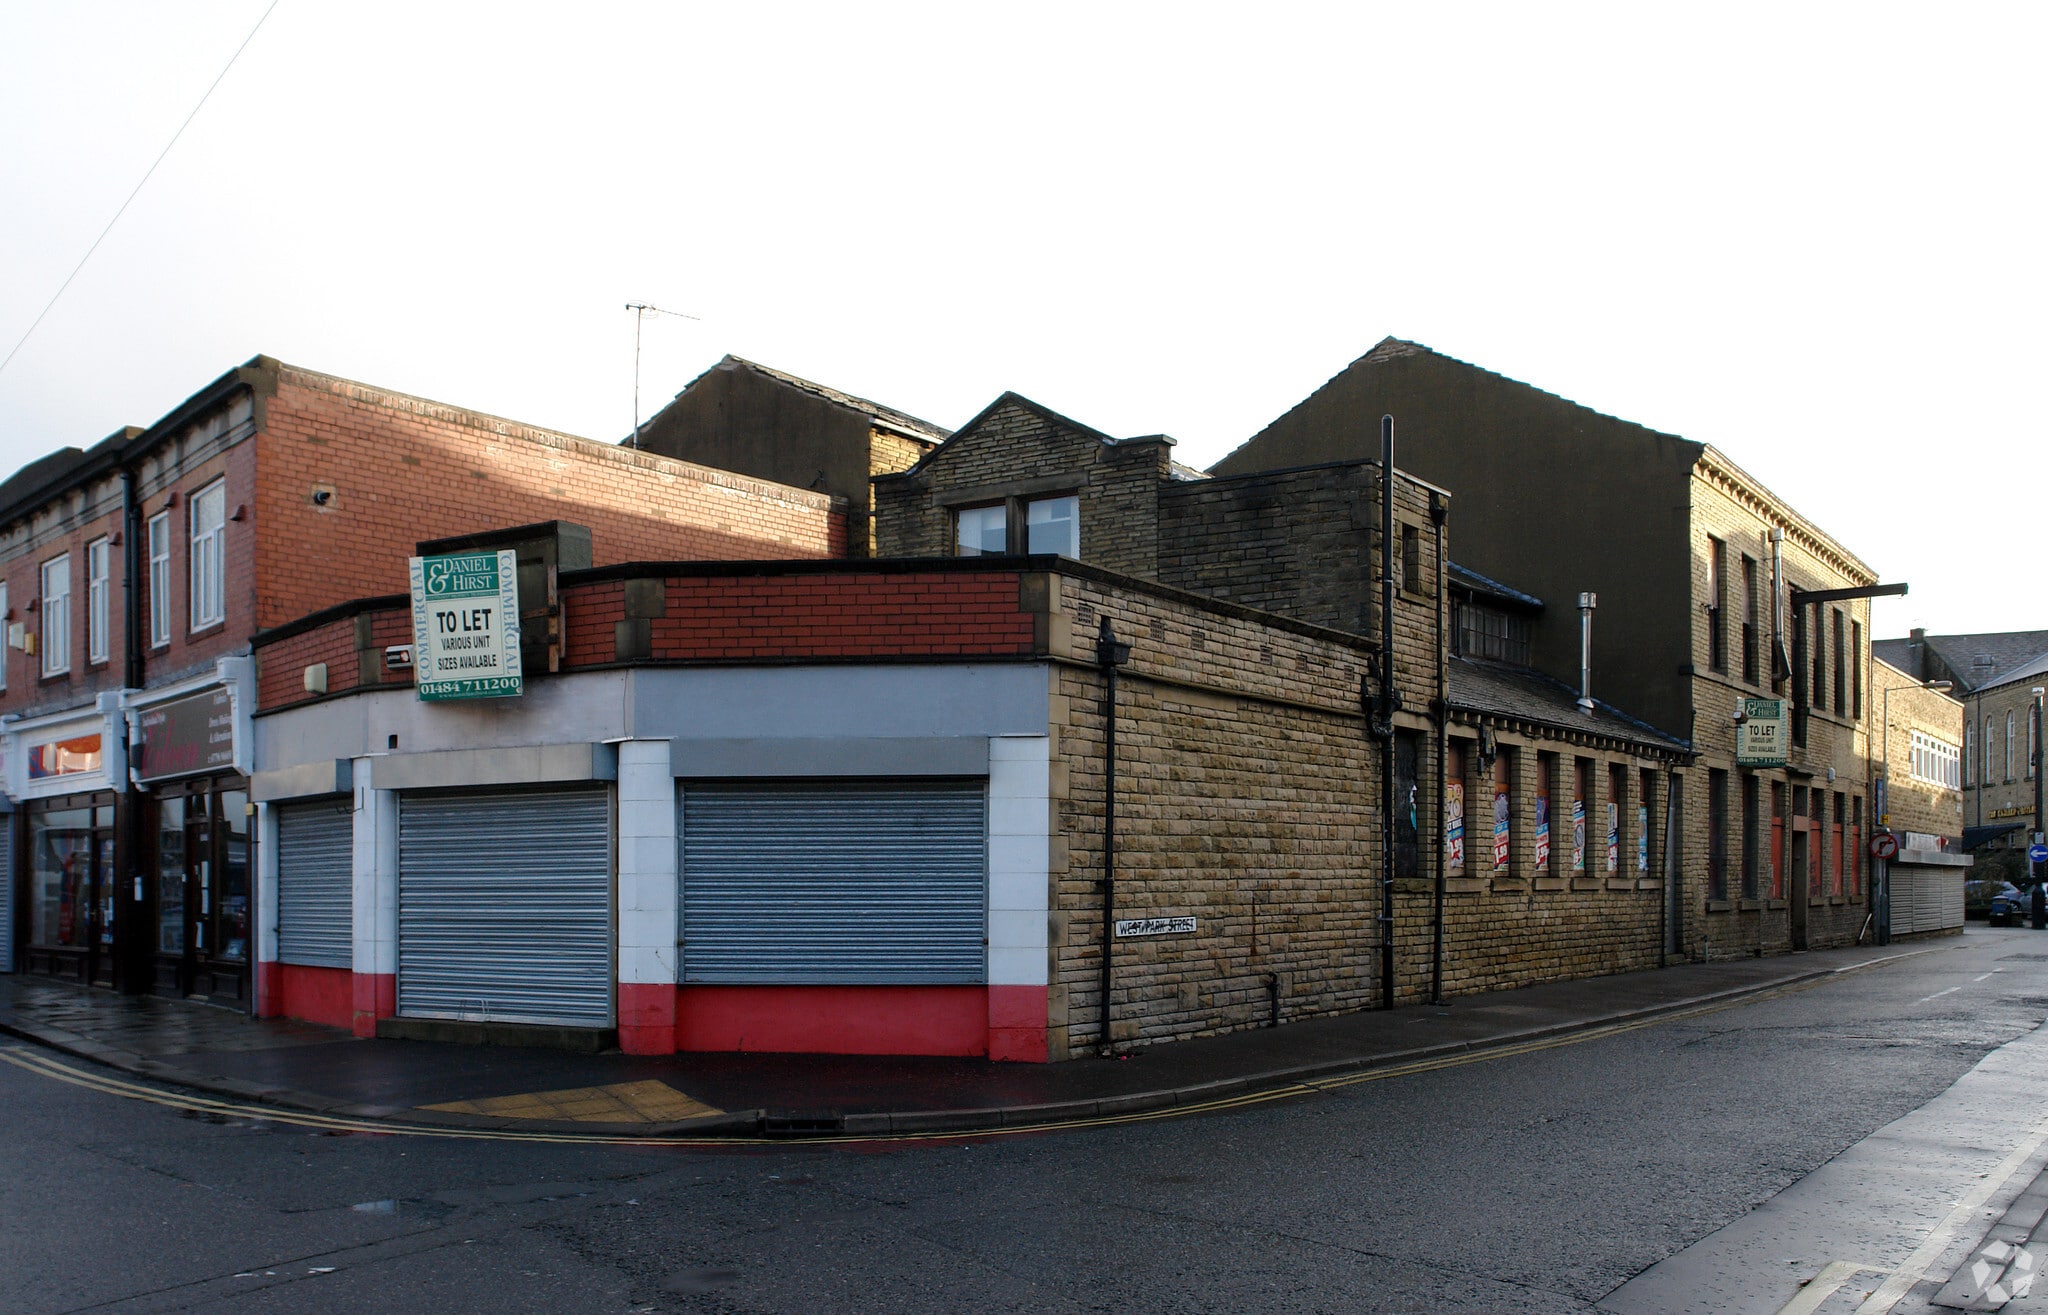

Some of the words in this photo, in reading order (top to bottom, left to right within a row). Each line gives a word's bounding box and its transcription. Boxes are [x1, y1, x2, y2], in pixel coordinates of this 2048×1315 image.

[443, 558, 491, 574] DANIEL
[427, 563, 449, 594] &
[453, 575, 493, 591] HIRST
[410, 561, 432, 680] COMMERCIAL
[436, 610, 457, 634] TO
[462, 608, 492, 632] LET
[499, 553, 518, 674] COMMERCIAL
[441, 636, 472, 651] VARIOUS
[473, 635, 490, 649] UNIT
[438, 656, 458, 671] SIZES
[459, 654, 497, 669] AVAILABLE
[420, 680, 461, 695] 01484
[462, 677, 520, 693] 711200
[1749, 725, 1760, 736] TO
[1761, 725, 1776, 736] LET
[1119, 921, 1143, 935] WEST
[1144, 919, 1166, 933] PARK
[1167, 918, 1195, 932] STREET
